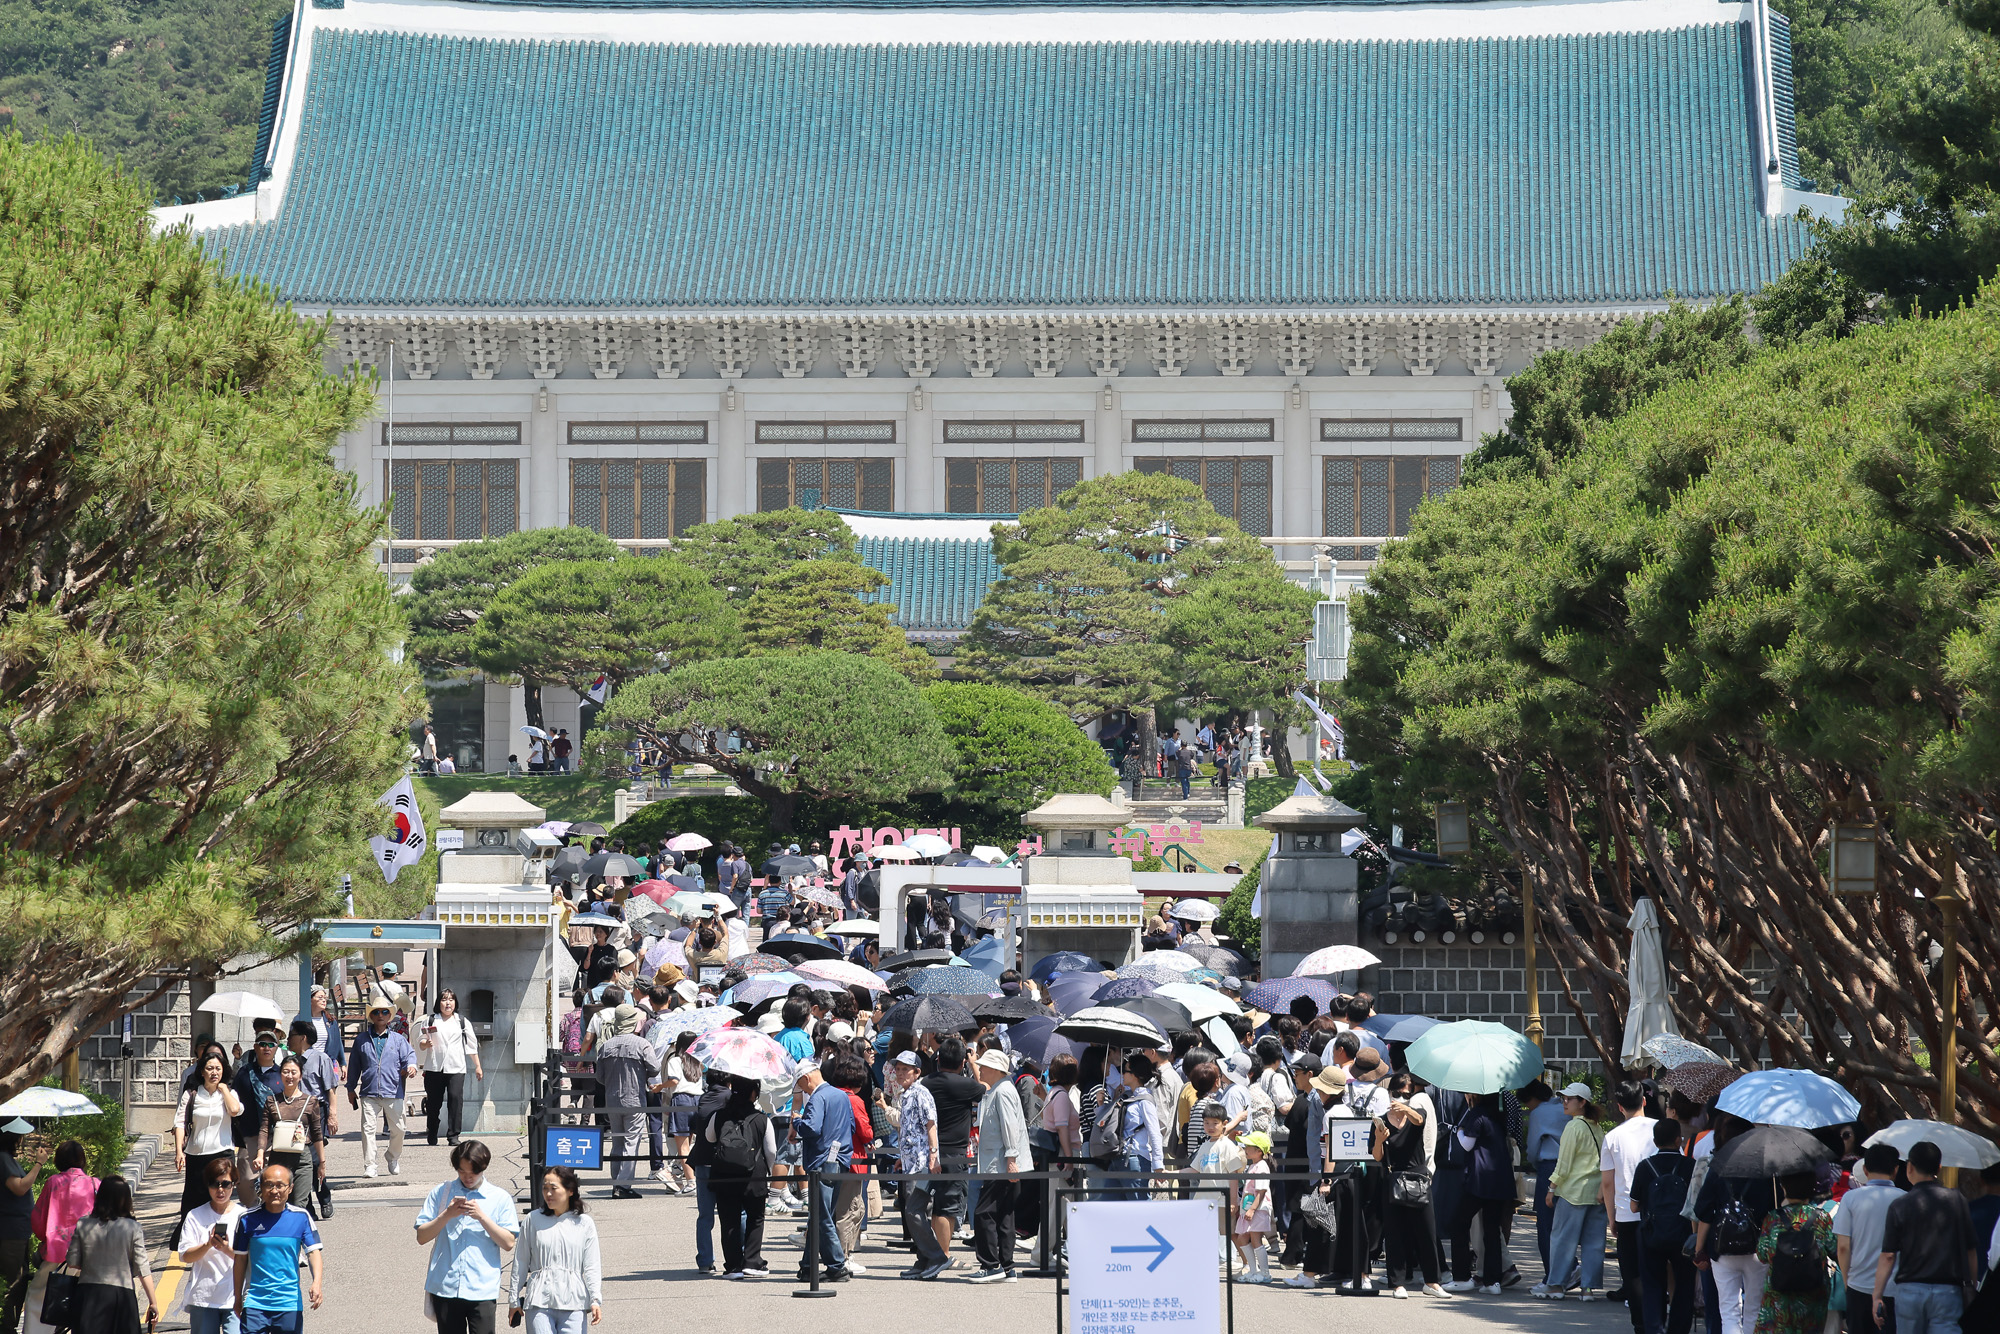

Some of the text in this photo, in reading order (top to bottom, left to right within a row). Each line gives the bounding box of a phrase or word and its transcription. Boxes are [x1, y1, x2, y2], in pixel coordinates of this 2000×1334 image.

[1108, 827, 1144, 861] 국민
[1148, 820, 1204, 856] 품으로
[556, 1137, 592, 1155] 출구
[1105, 1263, 1132, 1272] 220m
[1080, 1297, 1183, 1309] 단체(11~50인)는 춘추문,
[1081, 1310, 1195, 1322] 개인은 정문 또는 춘추문으로
